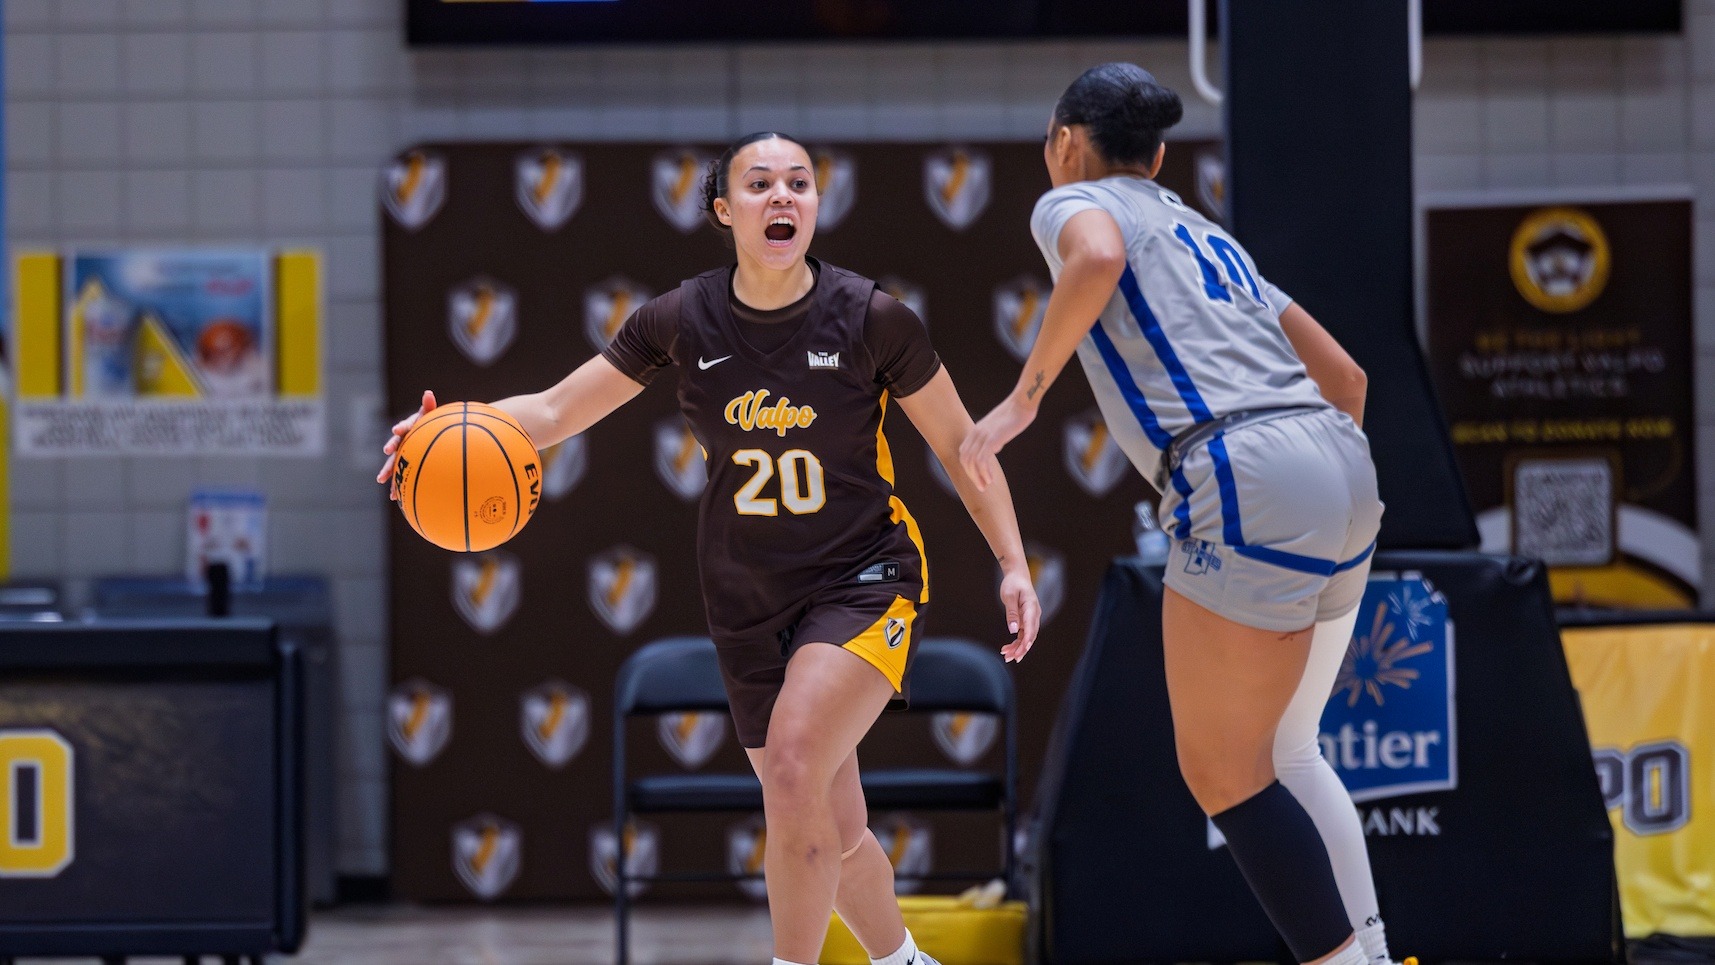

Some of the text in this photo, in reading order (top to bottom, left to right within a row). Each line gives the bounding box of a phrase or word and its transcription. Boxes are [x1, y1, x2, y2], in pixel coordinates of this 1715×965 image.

[1169, 219, 1270, 308] 10
[807, 350, 840, 368] VALLEY
[724, 388, 818, 437] Valpo
[731, 449, 827, 517] 20
[887, 567, 896, 577] M
[1357, 806, 1441, 836] ANK
